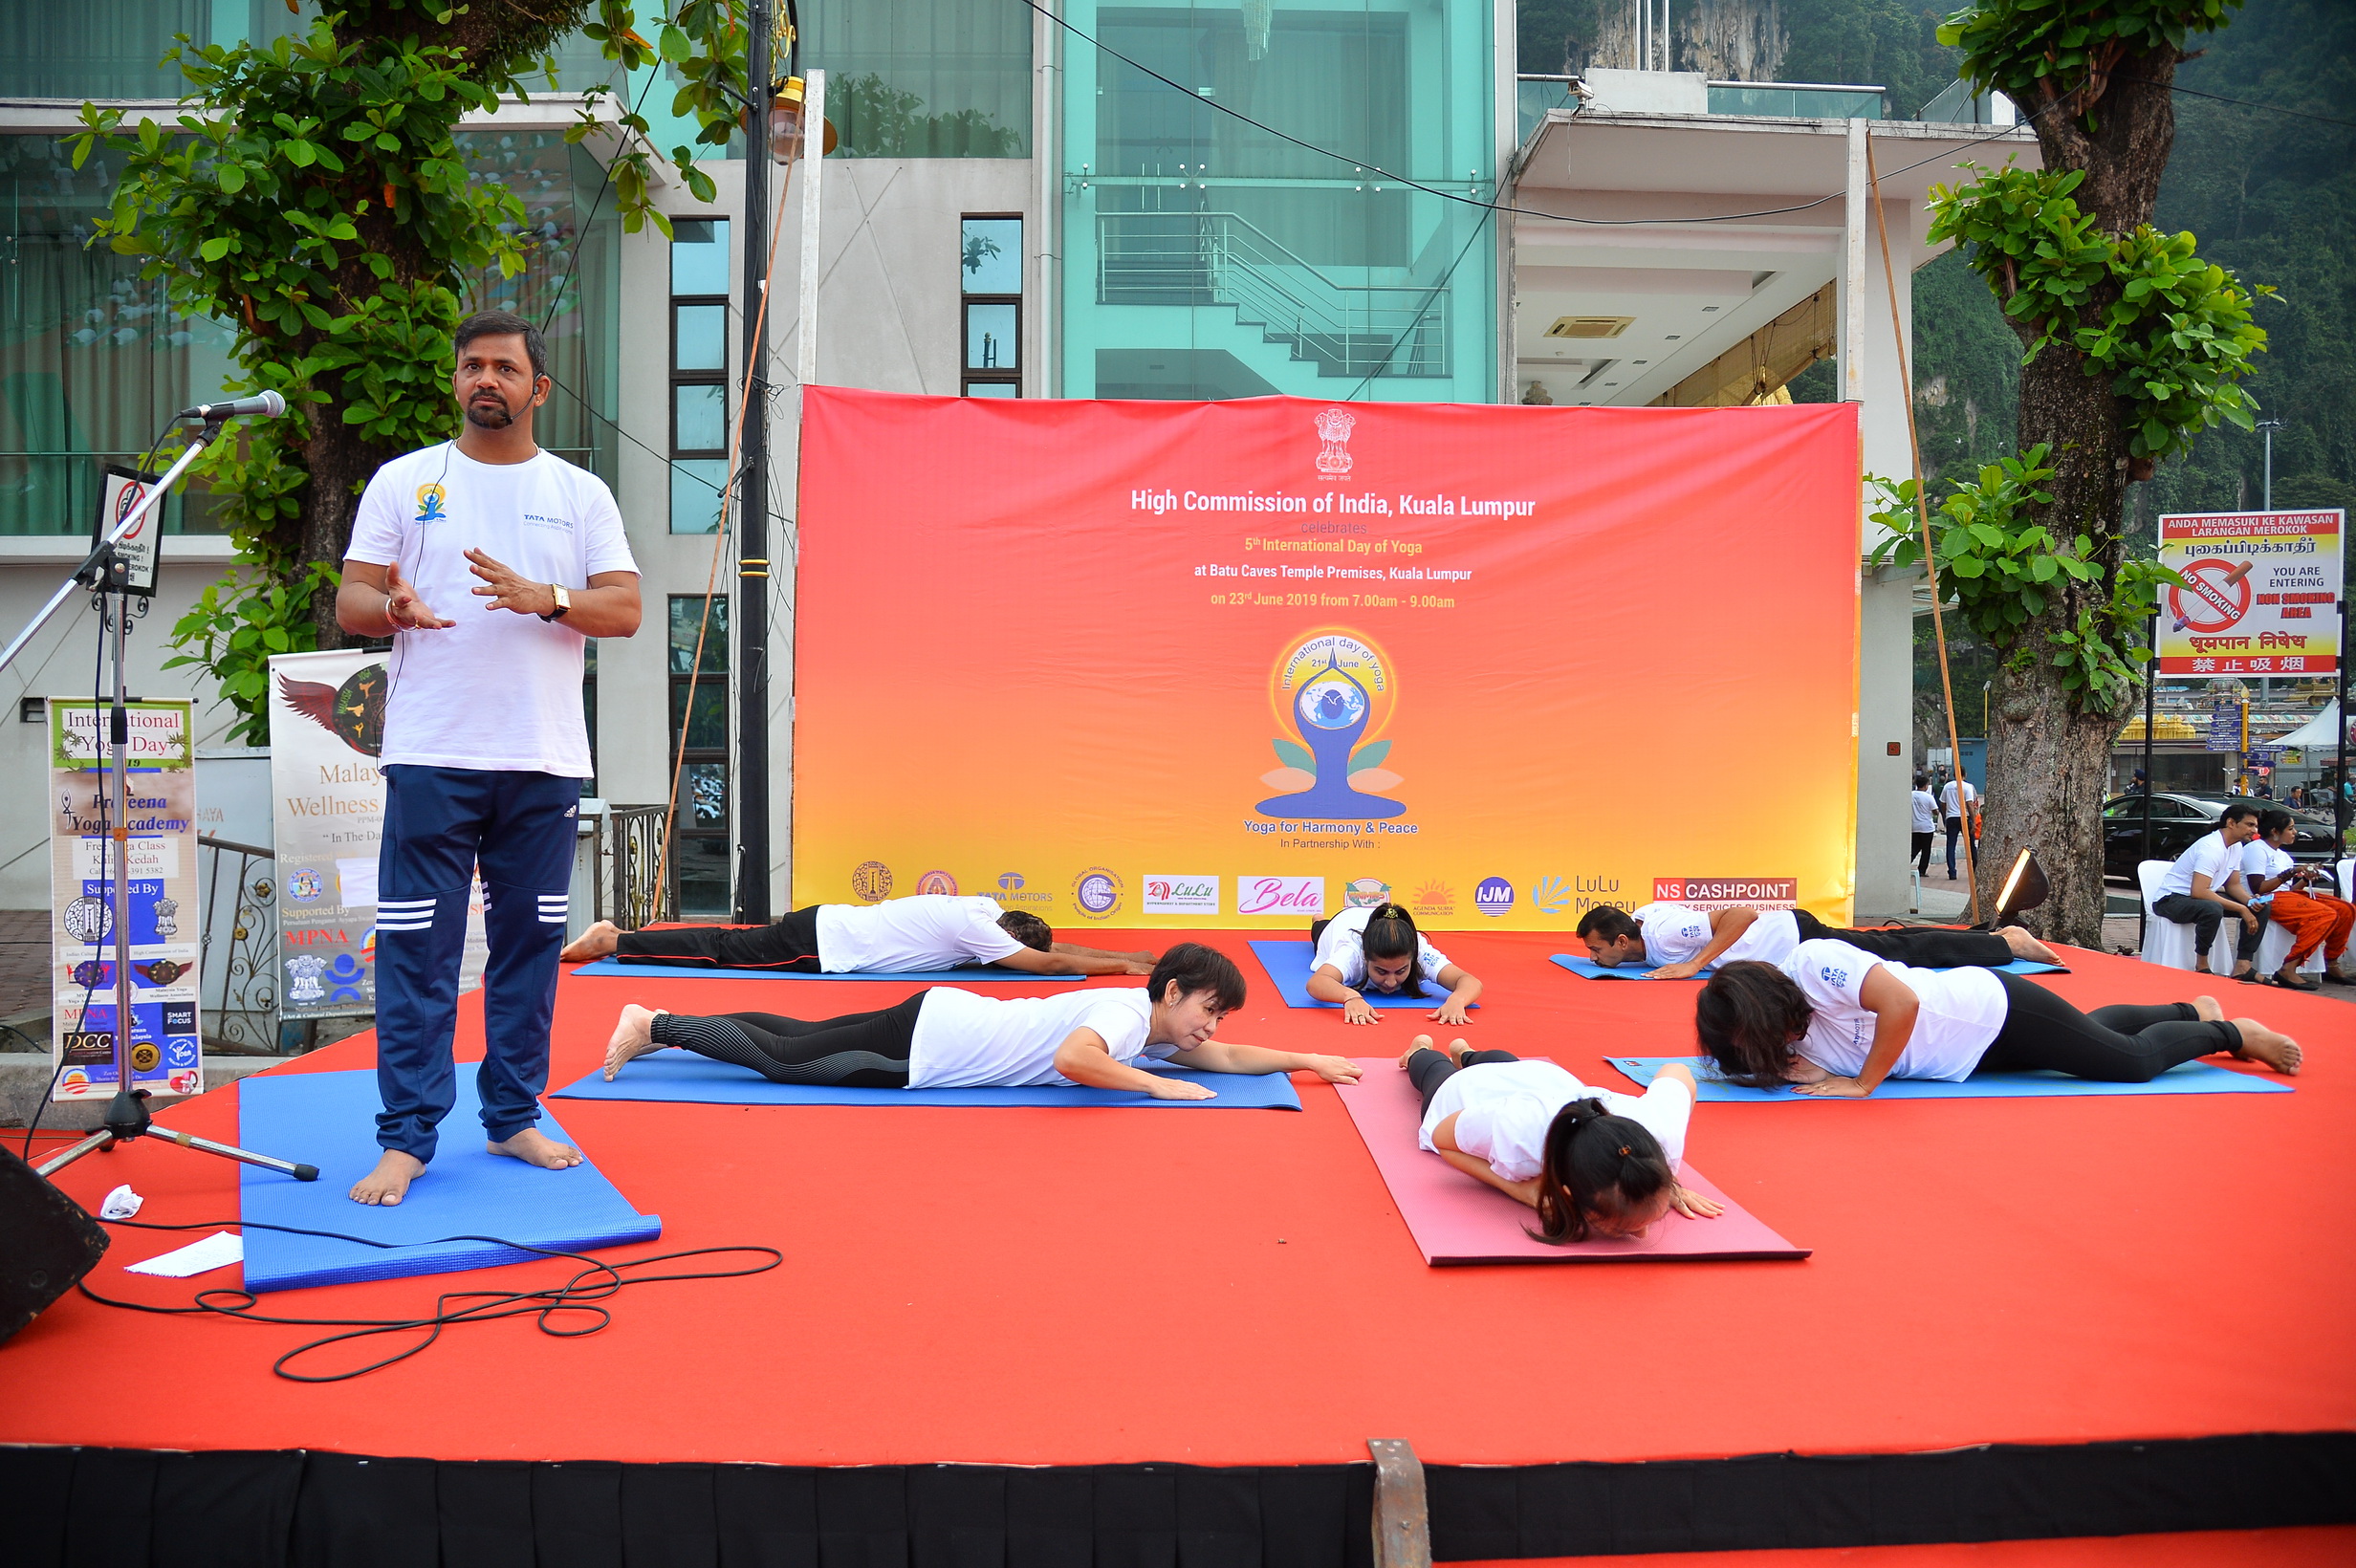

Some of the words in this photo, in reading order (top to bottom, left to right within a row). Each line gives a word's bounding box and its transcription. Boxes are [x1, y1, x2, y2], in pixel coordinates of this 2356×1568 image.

[1131, 490, 1177, 514] High
[1184, 491, 1306, 514] Commission
[1312, 492, 1333, 513] of
[1339, 493, 1393, 517] India,
[1399, 494, 1454, 516] Kuala
[1460, 496, 1536, 521] Lumpur
[547, 517, 574, 529] MOTORS
[1301, 520, 1367, 534] celebrates
[2169, 519, 2198, 528] ANDA
[2201, 517, 2258, 528] MEMASUKI
[2262, 516, 2276, 526] KE
[2279, 514, 2333, 525] KAWASAN
[2192, 527, 2251, 537] LARANGAN
[2254, 525, 2307, 535] MEROKOK
[1245, 536, 1261, 551] 5th
[1263, 538, 1344, 553] International
[1347, 539, 1371, 555] Day
[1374, 539, 1387, 553] of
[1391, 540, 1423, 556] Yoga
[1194, 565, 1207, 577] at
[1210, 564, 1237, 577] Batu
[1241, 564, 1277, 578] Caves
[1280, 565, 1323, 581] Temple
[1327, 566, 1386, 581] Premises,
[1389, 567, 1424, 580] Kuala
[1427, 568, 1472, 583] Lumpur
[2273, 567, 2296, 576] YOU
[2299, 566, 2321, 576] ARE
[2269, 577, 2324, 588] ENTERING
[1211, 596, 1226, 606] on
[1229, 592, 1253, 607] 23rd
[1254, 594, 1283, 606] June
[1286, 594, 1318, 607] 2019
[1320, 594, 1350, 607] from
[1353, 594, 1398, 608] 7.00am
[1410, 595, 1455, 609] 9.00am
[2181, 569, 2197, 585] NO
[2195, 581, 2241, 621] SMOKING
[2257, 594, 2280, 605] NON
[2281, 592, 2335, 604] SMOKING
[2280, 607, 2312, 619] AREA
[1339, 638, 1361, 654] day
[1282, 637, 1336, 689] International
[1311, 659, 1327, 667] 21st
[1338, 659, 1359, 668] June
[1362, 650, 1375, 663] of
[2192, 656, 2304, 672] 禁止吸烟
[1368, 663, 1385, 691] yoga
[68, 711, 180, 729] Intertional
[81, 735, 114, 755] Yog
[133, 736, 168, 755] Day
[319, 763, 382, 786] Malay
[287, 795, 379, 817] Wellness
[127, 817, 191, 834] cademy
[1244, 820, 1276, 835] Yoga
[1279, 821, 1298, 833] for
[1302, 821, 1362, 836] Harmony
[1365, 822, 1375, 833] &
[1379, 821, 1418, 834] Peace
[344, 832, 363, 842] The
[1280, 838, 1290, 849] In
[1293, 838, 1350, 850] Partnership
[1352, 839, 1375, 849] With
[138, 841, 166, 850] Class
[280, 852, 333, 865] Registered
[1071, 869, 1088, 888] GLOBAL
[1089, 866, 1124, 888] ORGANISATION
[1576, 875, 1619, 892] LuLu
[142, 883, 159, 896] By
[1010, 893, 1053, 902] MOTORS
[1171, 882, 1213, 897] LuLu
[1239, 878, 1322, 913] Bela
[1476, 886, 1511, 903] IJM
[1656, 883, 1681, 899] NS
[1686, 883, 1791, 899] CASHPOINT
[282, 905, 334, 919] Supported
[337, 904, 350, 916] By
[285, 928, 349, 947] MPNA
[65, 1034, 111, 1049] DCC
